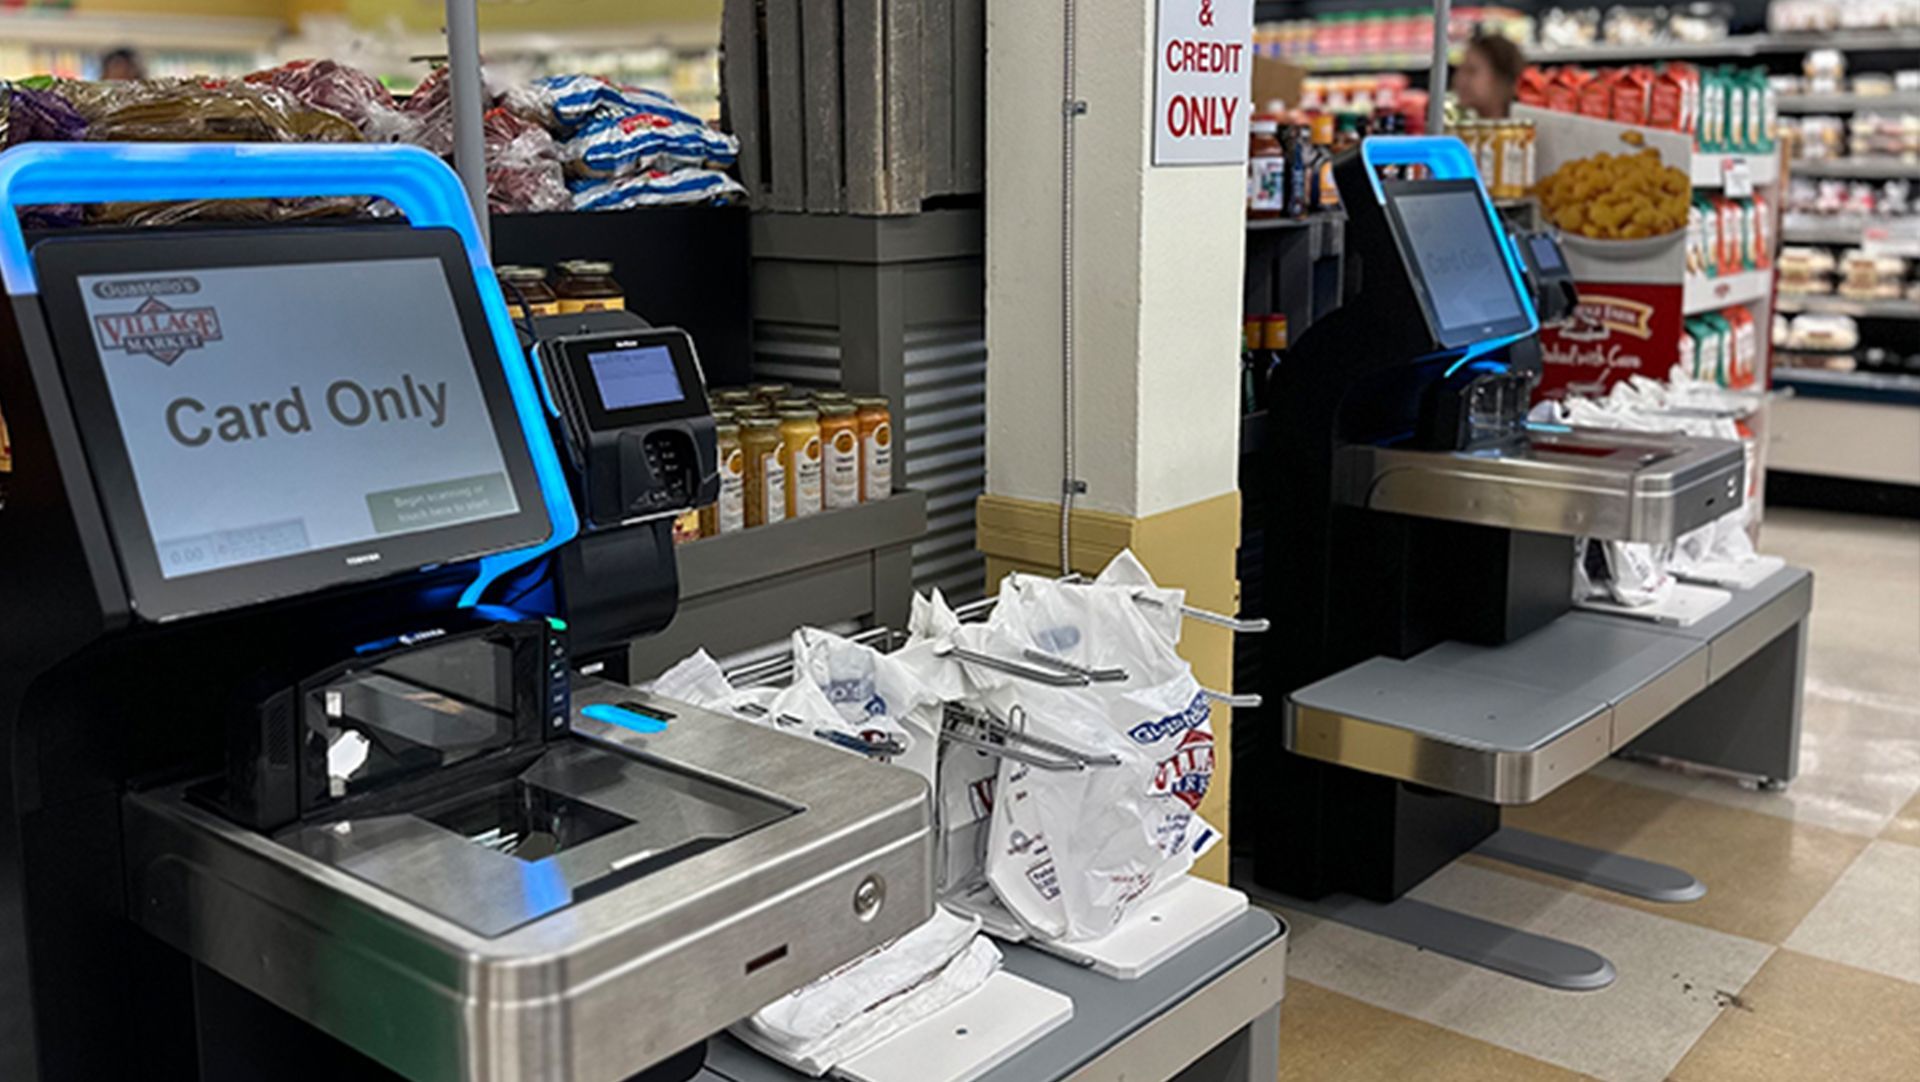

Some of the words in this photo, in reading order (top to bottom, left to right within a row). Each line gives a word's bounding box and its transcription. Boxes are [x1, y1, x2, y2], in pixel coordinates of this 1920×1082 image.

[1199, 0, 1213, 26] &
[1166, 39, 1243, 73] CREDIT
[1167, 95, 1239, 138] ONLY
[99, 309, 218, 347] VILLAGE
[127, 335, 200, 352] MARKET
[165, 386, 312, 448] Card
[325, 374, 446, 429] Only
